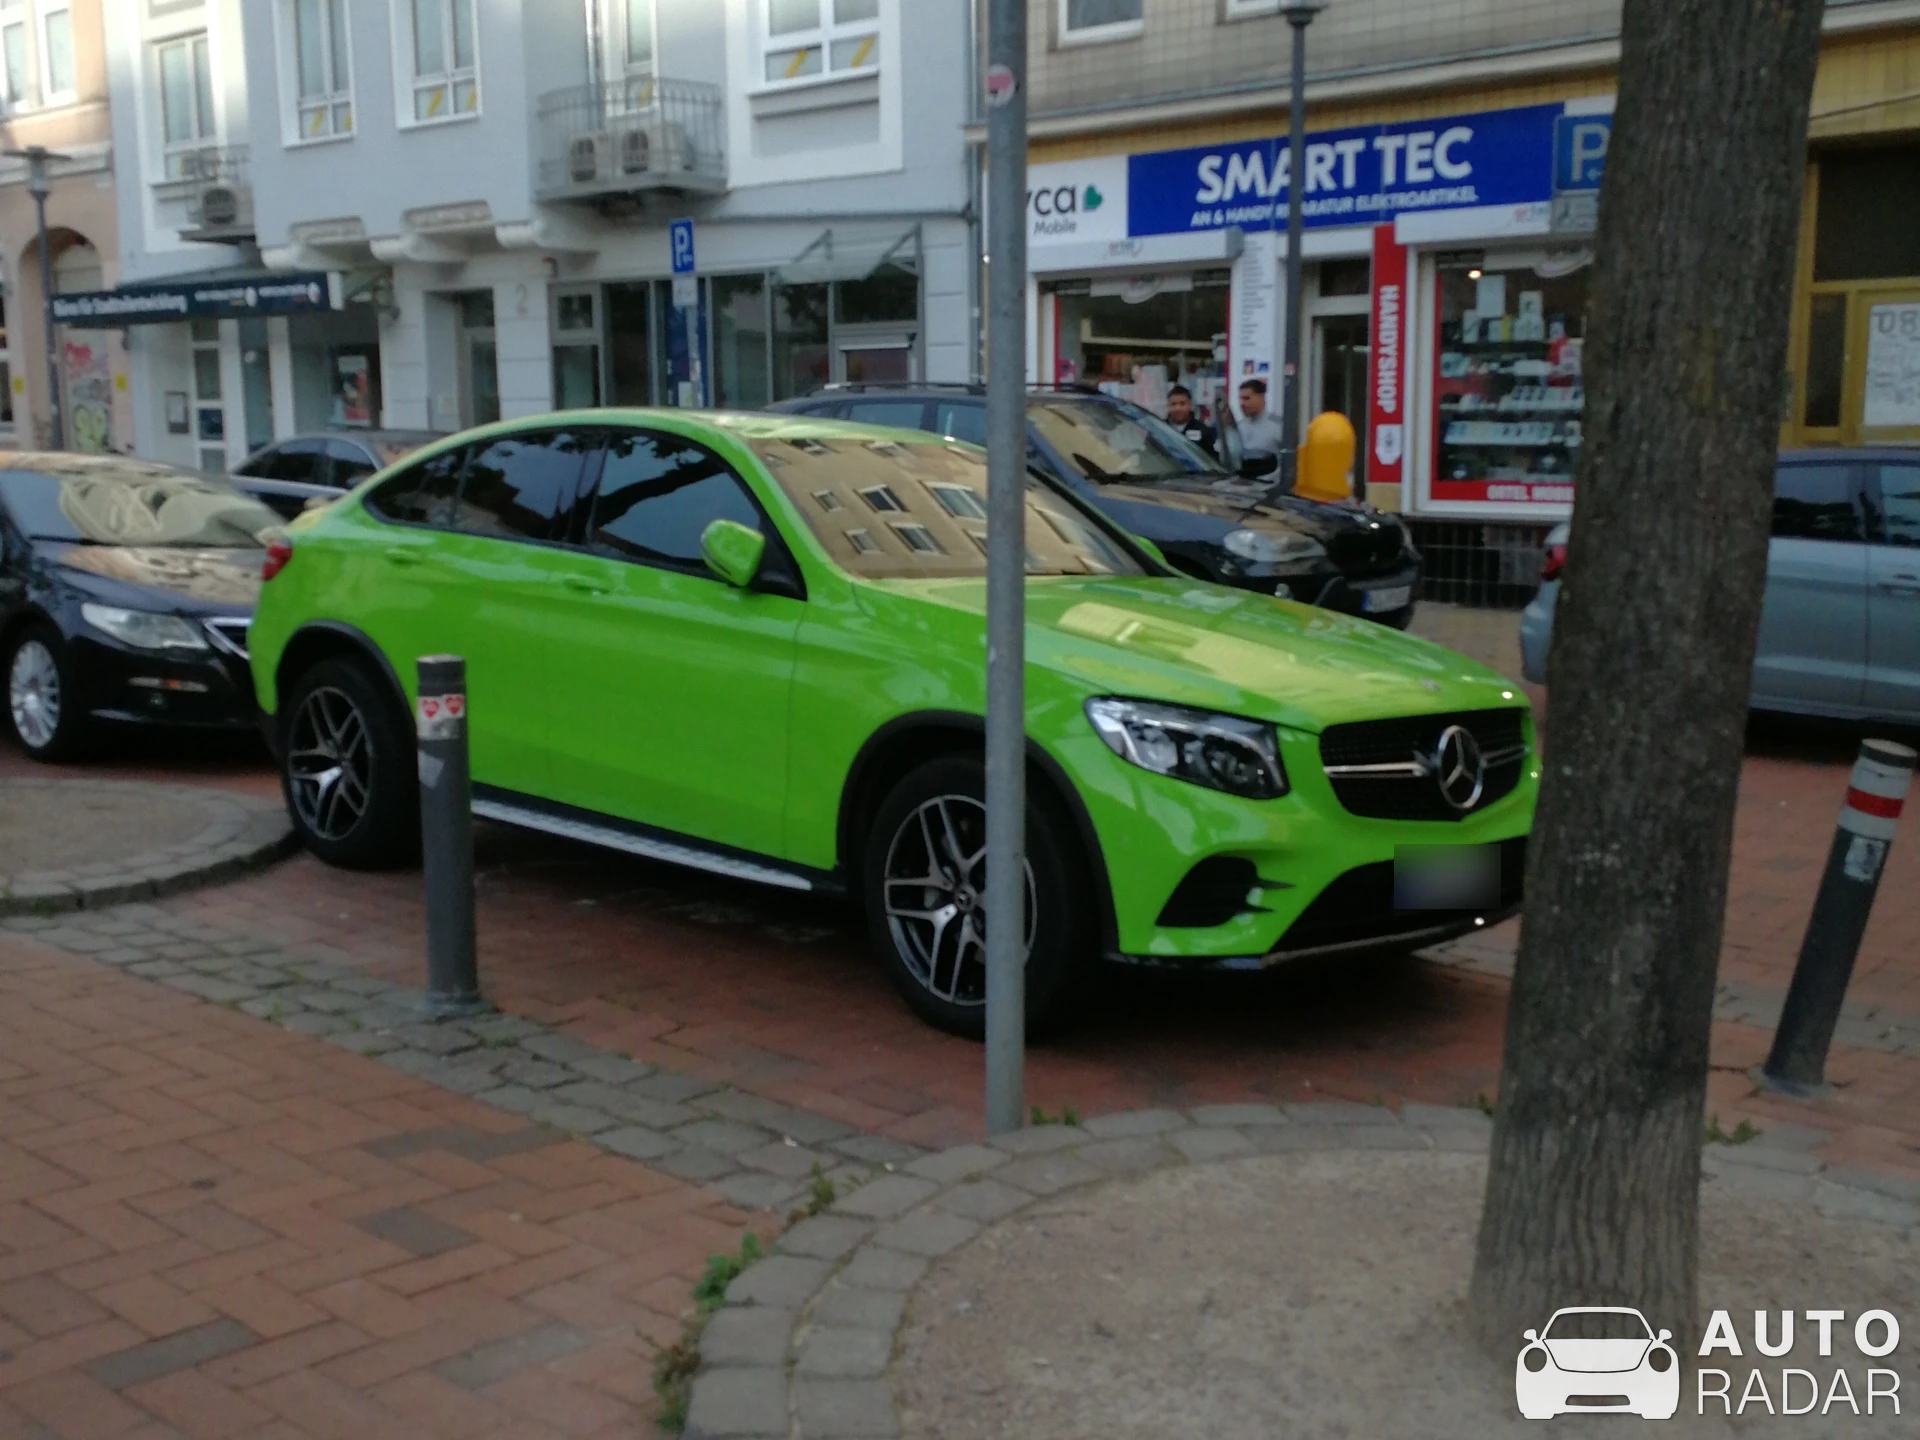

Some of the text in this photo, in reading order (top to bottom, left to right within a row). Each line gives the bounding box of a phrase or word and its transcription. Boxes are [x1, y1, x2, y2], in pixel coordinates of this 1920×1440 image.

[1195, 126, 1474, 204] SMART TEC
[1571, 123, 1611, 181] P
[1033, 219, 1077, 236] Mobile
[1275, 196, 1355, 219] REARATUR
[674, 225, 689, 269] P
[1376, 284, 1400, 414] HANDYSHOP
